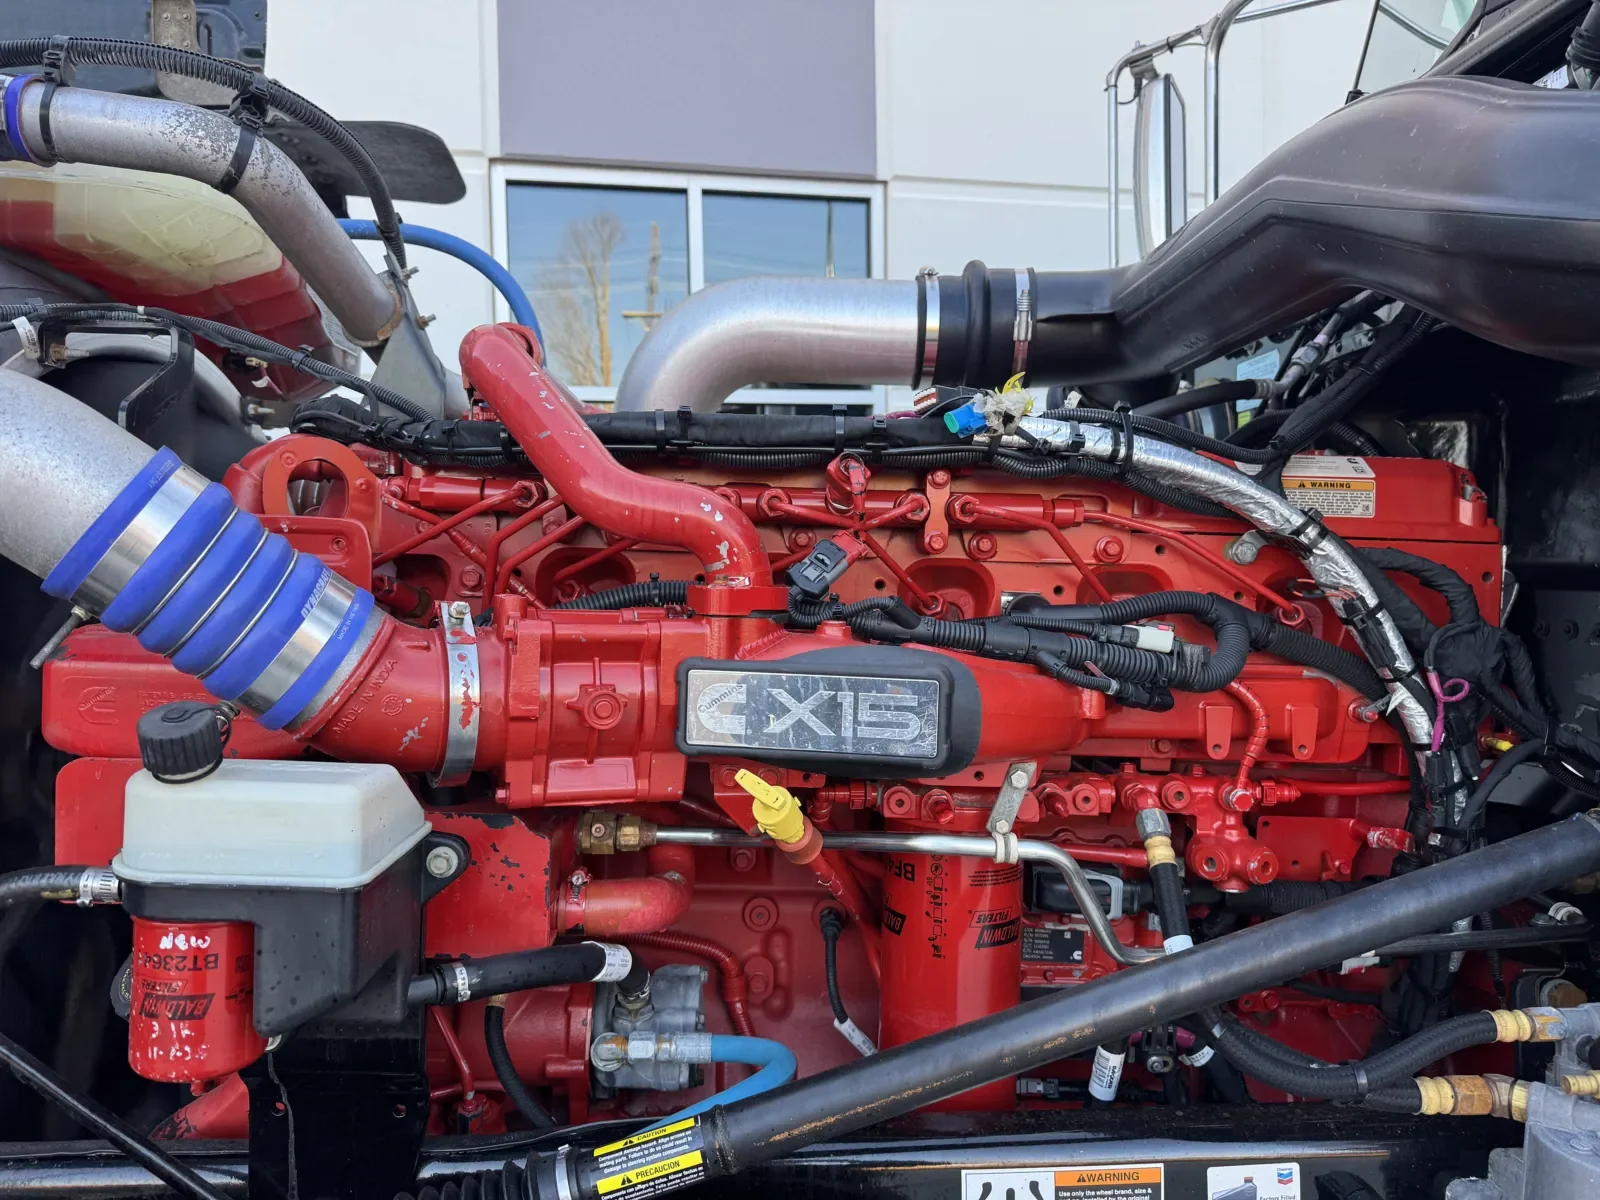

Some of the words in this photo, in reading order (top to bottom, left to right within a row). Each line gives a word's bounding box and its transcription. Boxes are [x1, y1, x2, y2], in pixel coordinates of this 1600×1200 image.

[1310, 481, 1351, 489] WARNING
[300, 567, 334, 621] DYNACRAFT
[337, 626, 349, 641] MADE
[78, 686, 116, 711] Cummins
[333, 702, 365, 736] MADE
[359, 689, 375, 705] IN
[372, 659, 397, 689] INDIA
[697, 683, 744, 714] Cummins
[763, 688, 921, 741] X15
[976, 910, 1009, 924] FILTERS
[980, 923, 1018, 944] BALDWIN
[143, 998, 207, 1016] BALDWIN
[637, 1128, 667, 1141] CAUTION
[598, 1151, 623, 1162] Component
[623, 1146, 641, 1154] damage
[599, 1160, 615, 1169] mating
[614, 1156, 628, 1164] parts.
[628, 1151, 644, 1159] Failure
[661, 1141, 675, 1149] could
[674, 1137, 688, 1145] result
[603, 1165, 622, 1174] damage
[627, 1157, 646, 1167] steering
[645, 1153, 662, 1163] system
[661, 1144, 690, 1157] components.
[636, 1160, 680, 1180] PRECAUCION
[1086, 1171, 1140, 1182] WARNING
